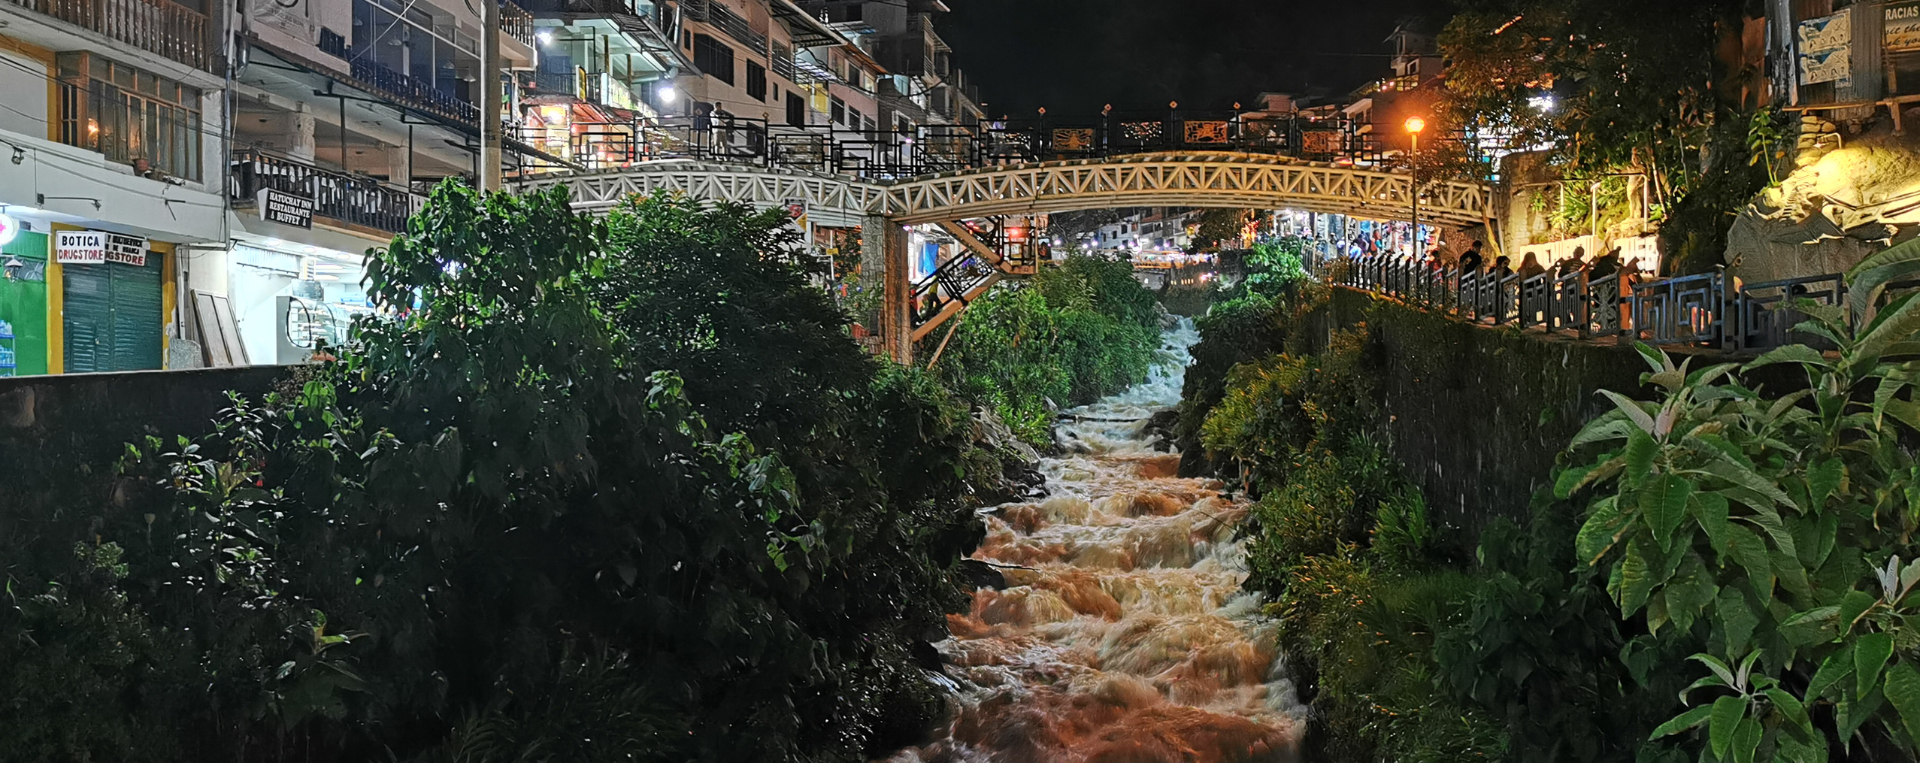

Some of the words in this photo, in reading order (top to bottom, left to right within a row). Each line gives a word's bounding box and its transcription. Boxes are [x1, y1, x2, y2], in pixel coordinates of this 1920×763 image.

[269, 192, 301, 207] HATUCHAY
[269, 201, 310, 218] RESTAURANTE
[276, 212, 300, 225] BUFFET
[62, 236, 99, 246] BOTICA
[58, 249, 103, 260] DRUGSTORE
